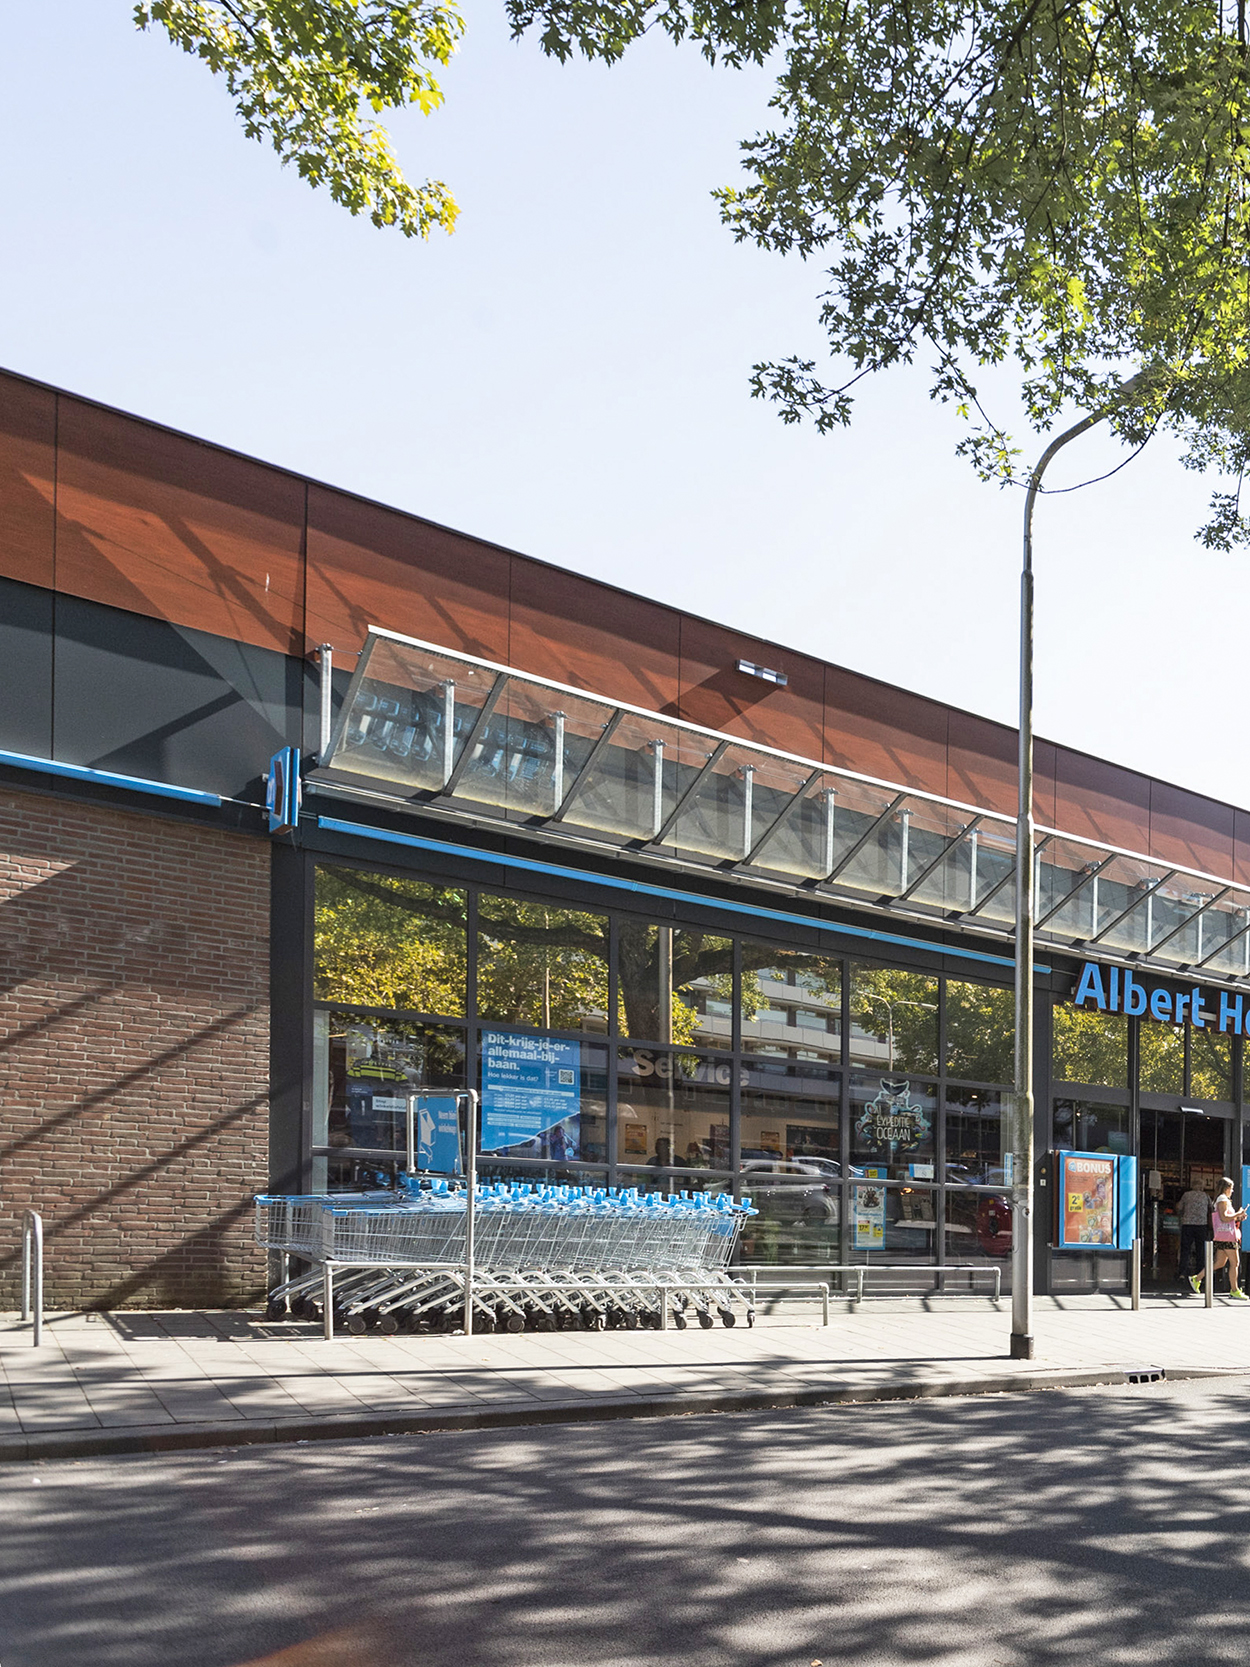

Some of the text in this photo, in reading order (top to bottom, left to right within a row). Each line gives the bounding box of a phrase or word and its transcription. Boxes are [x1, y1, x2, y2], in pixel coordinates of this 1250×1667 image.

[1075, 962, 1205, 1028] Albert
[487, 1034, 571, 1051] Dit-krijg-je-er-
[487, 1046, 560, 1064] allemaal-bij-
[487, 1058, 520, 1070] baan.
[501, 1072, 519, 1080] lekker
[876, 1127, 911, 1141] OCEAAN
[1076, 1162, 1111, 1174] BONUS
